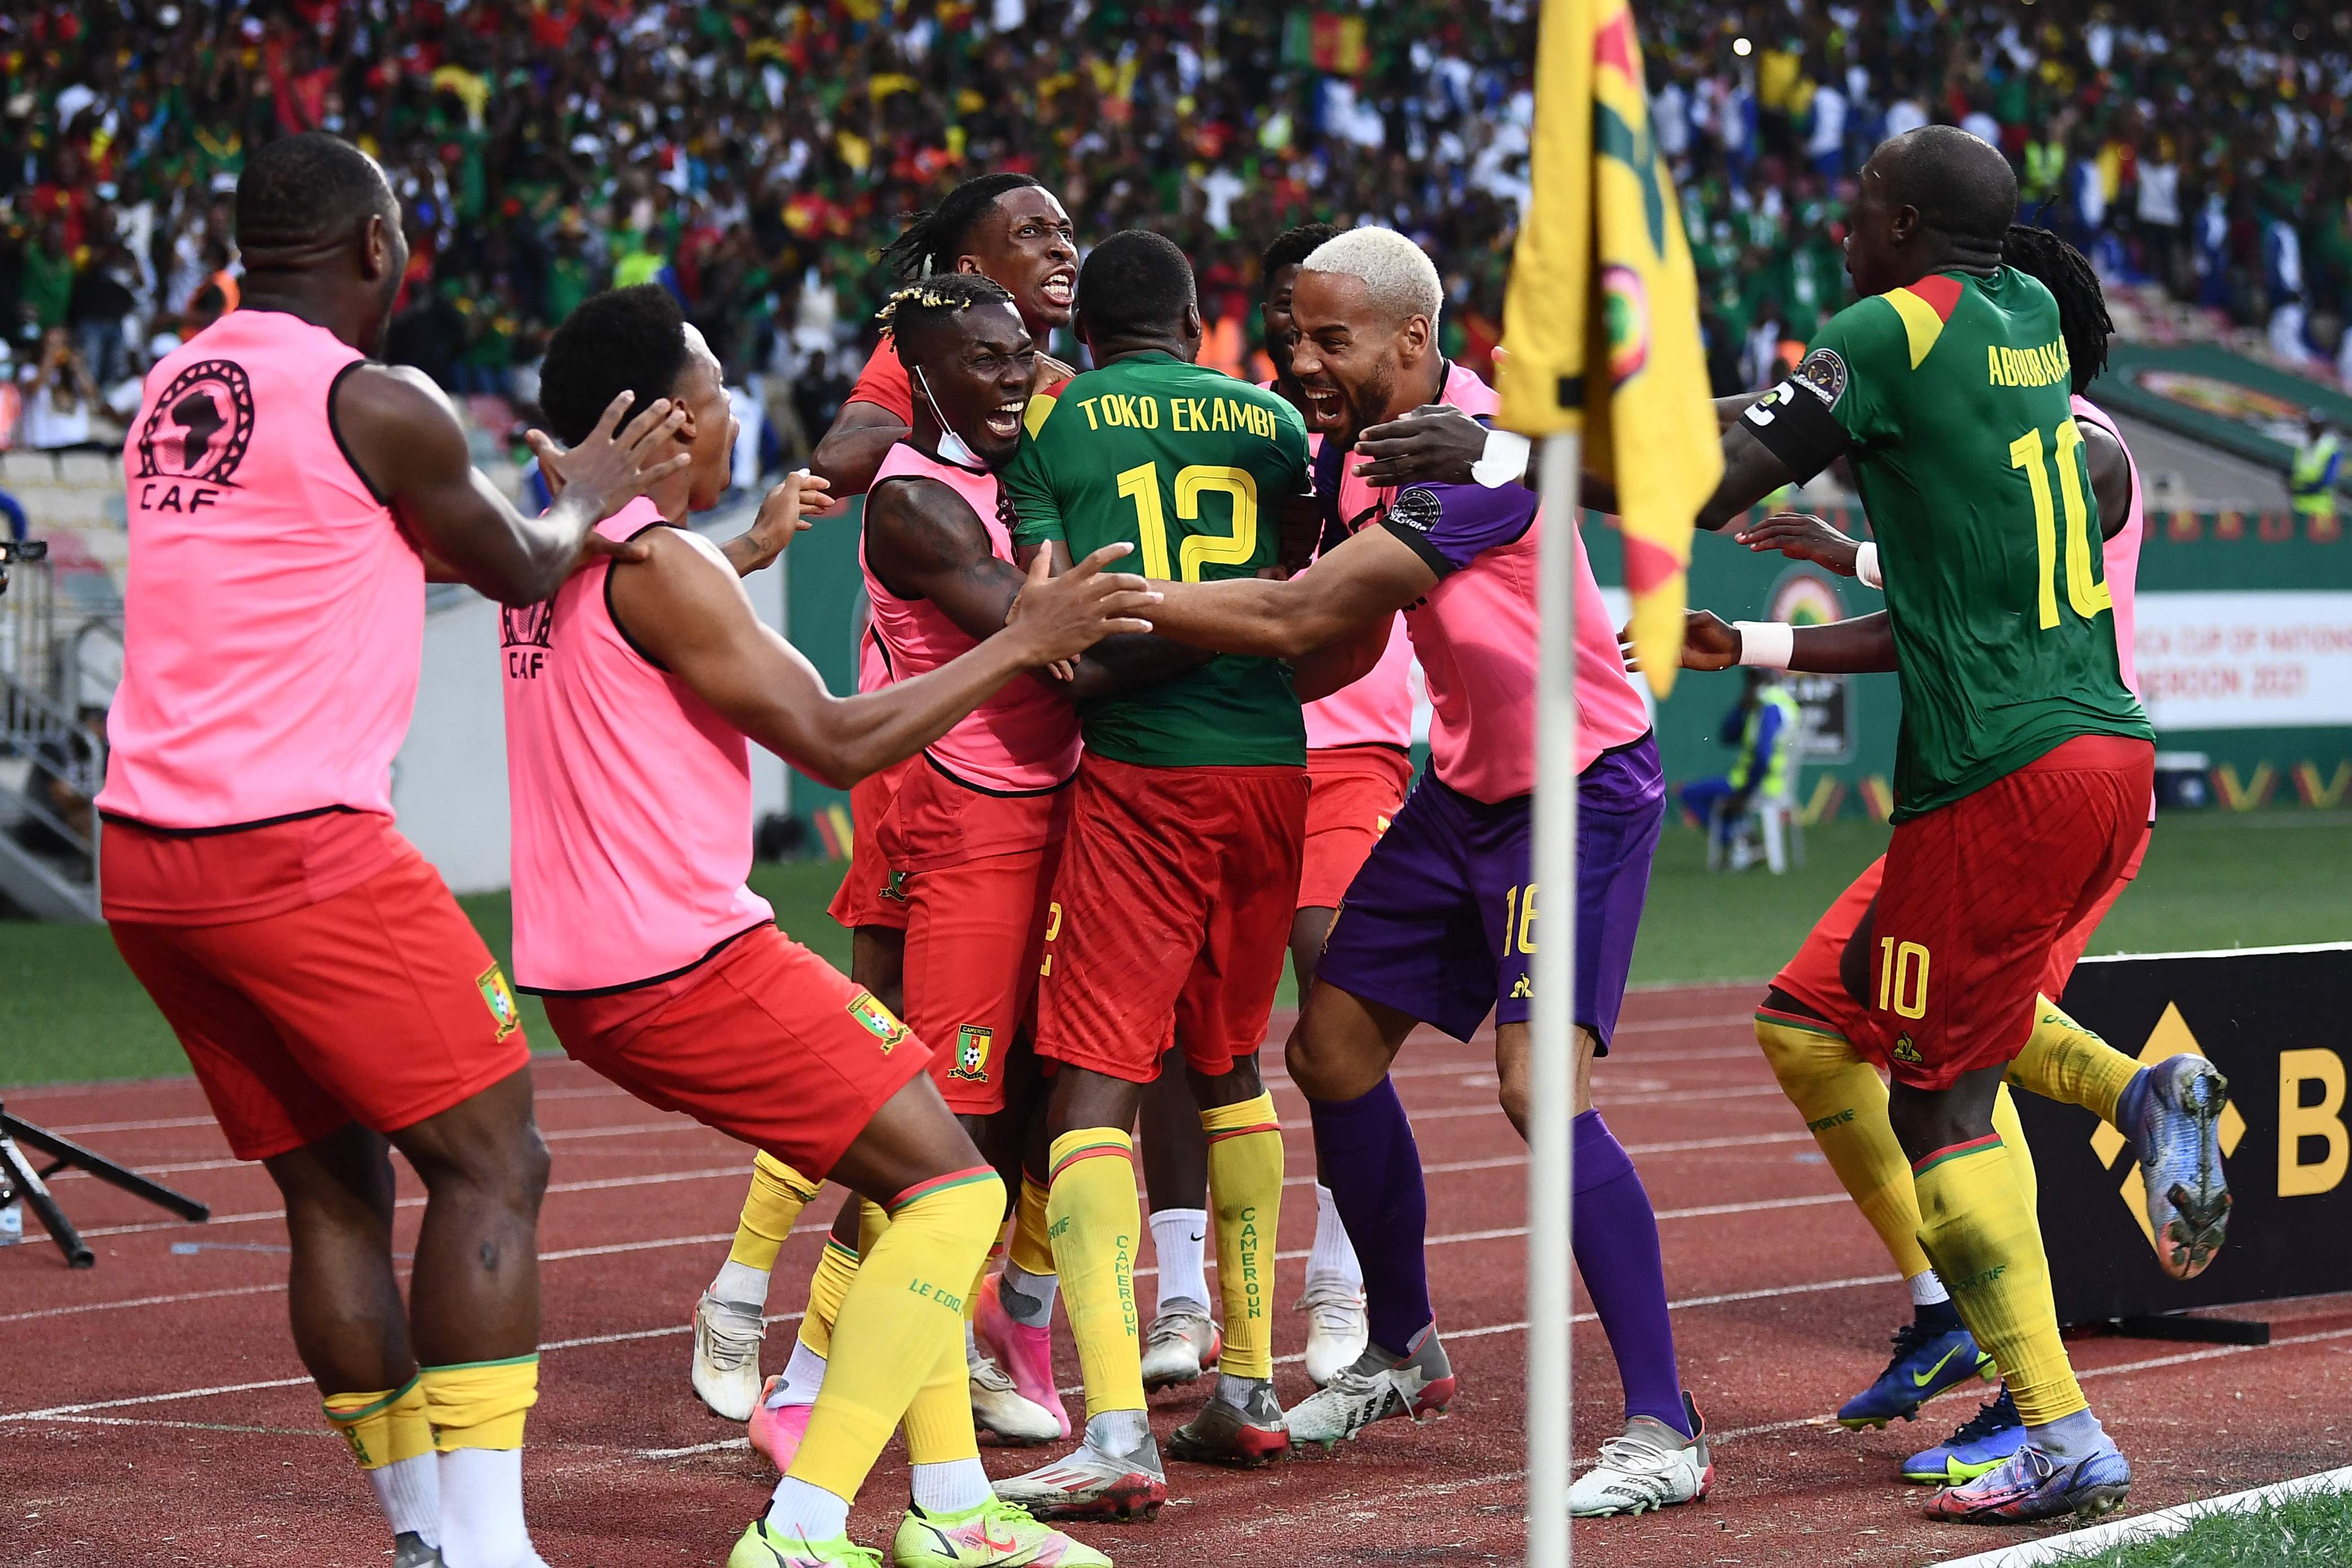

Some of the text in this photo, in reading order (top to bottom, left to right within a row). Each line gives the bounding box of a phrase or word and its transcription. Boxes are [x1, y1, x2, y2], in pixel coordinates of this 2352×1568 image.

[1076, 394, 1277, 441] TOKO EKAMBI
[140, 483, 220, 514] CAF
[1116, 461, 1258, 584] 12
[509, 652, 544, 679] CAF
[1879, 936, 1930, 1019] 10
[909, 1278, 961, 1313] LE COQ
[1115, 1234, 1136, 1337] CAMEROUN
[1241, 1207, 1260, 1319] CAMEROUN
